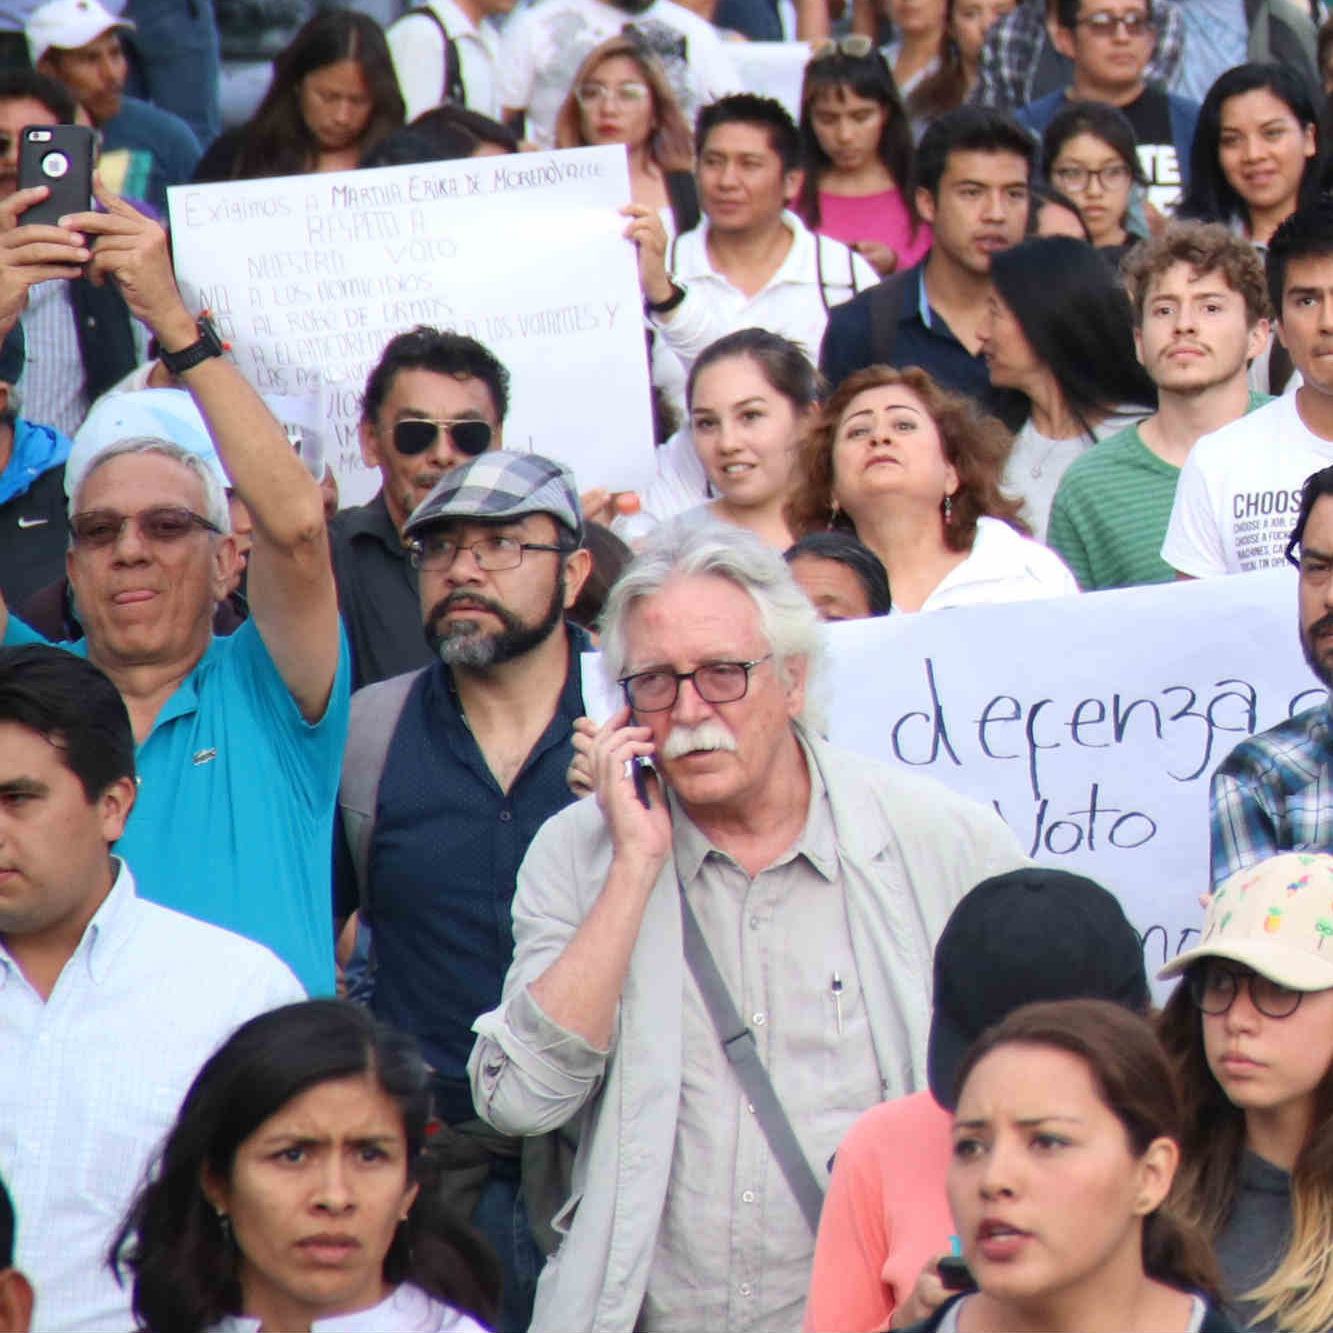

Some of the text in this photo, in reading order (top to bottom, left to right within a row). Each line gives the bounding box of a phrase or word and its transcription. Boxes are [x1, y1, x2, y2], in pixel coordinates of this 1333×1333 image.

[385, 237, 457, 264] VOTO
[199, 284, 232, 315] NO
[1233, 489, 1303, 518] CHOOS
